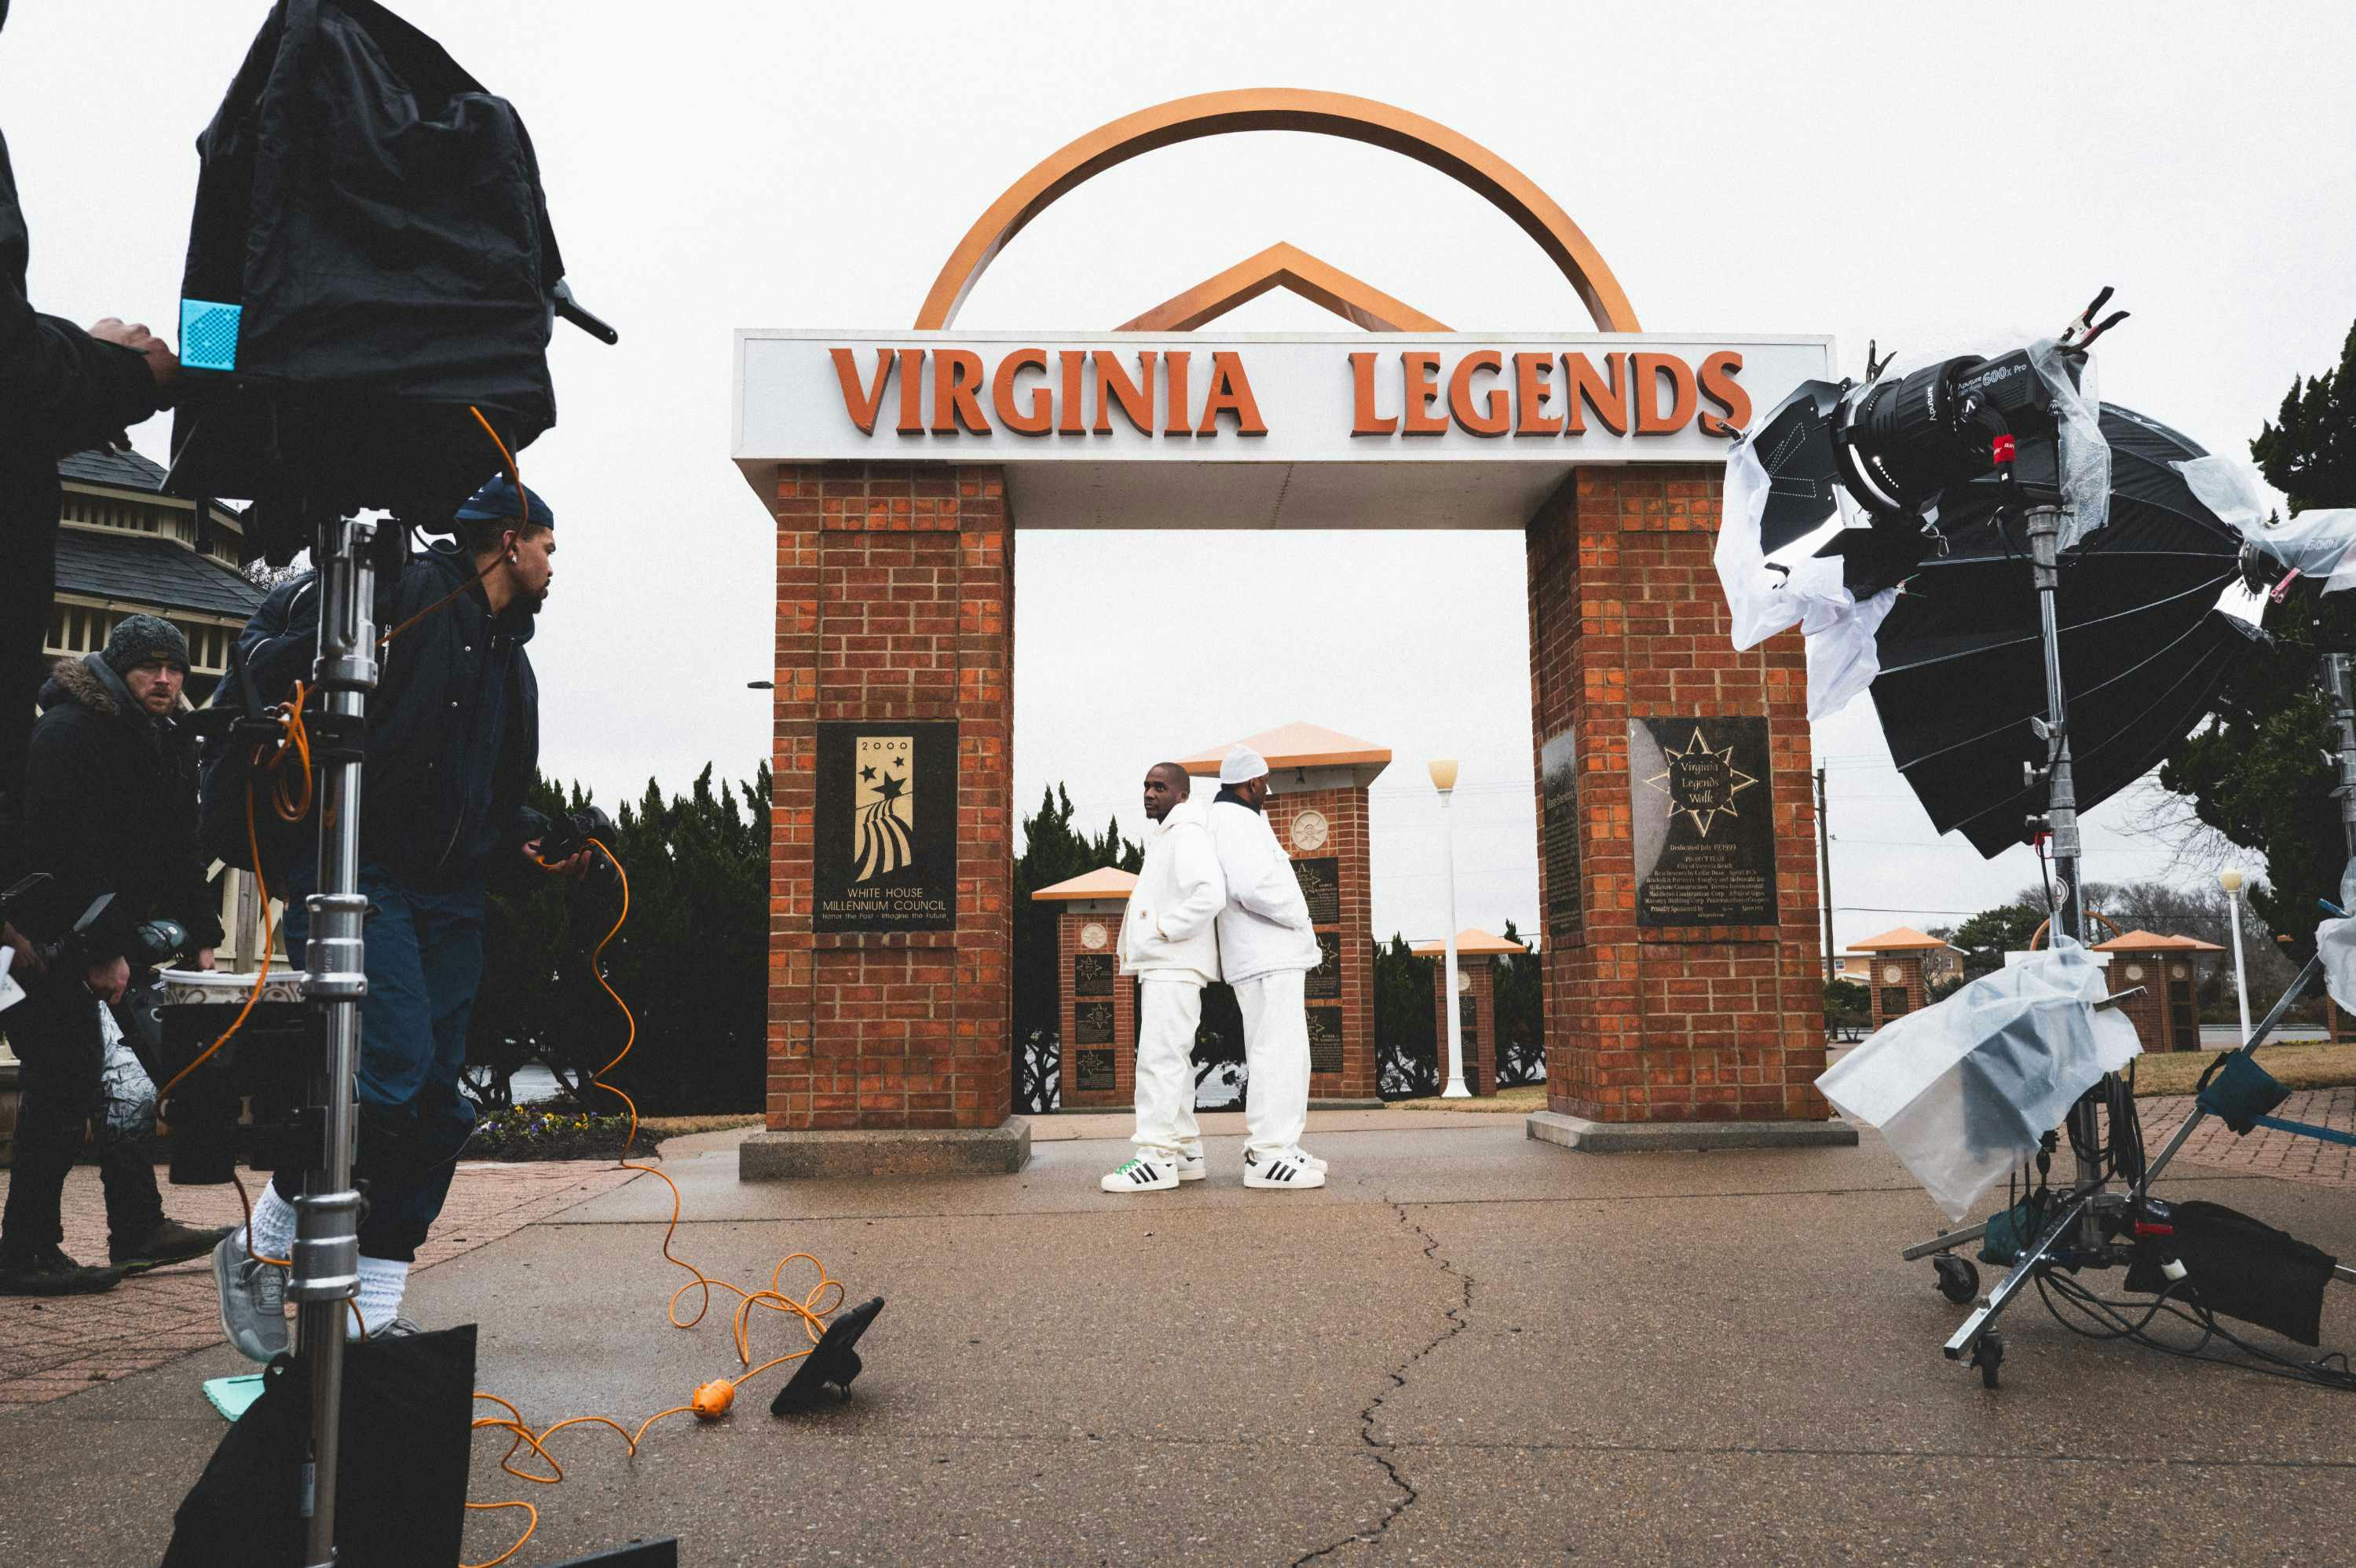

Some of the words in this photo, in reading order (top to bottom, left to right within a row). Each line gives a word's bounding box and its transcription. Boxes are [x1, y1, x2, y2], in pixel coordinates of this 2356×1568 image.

[2014, 364, 2027, 374] Pro
[829, 347, 1268, 438] VIRGINIA
[1349, 351, 1753, 437] LEGENDS
[1927, 386, 1937, 421] Aputure
[862, 741, 908, 751] 2000
[1681, 761, 1718, 775] Virginia
[1682, 777, 1720, 790] Legends
[1688, 790, 1714, 804] Walk
[847, 888, 880, 897] WHITE
[886, 887, 924, 897] HOUSE
[823, 901, 888, 911] MILLENNIUM
[894, 900, 946, 911] COUNCIL
